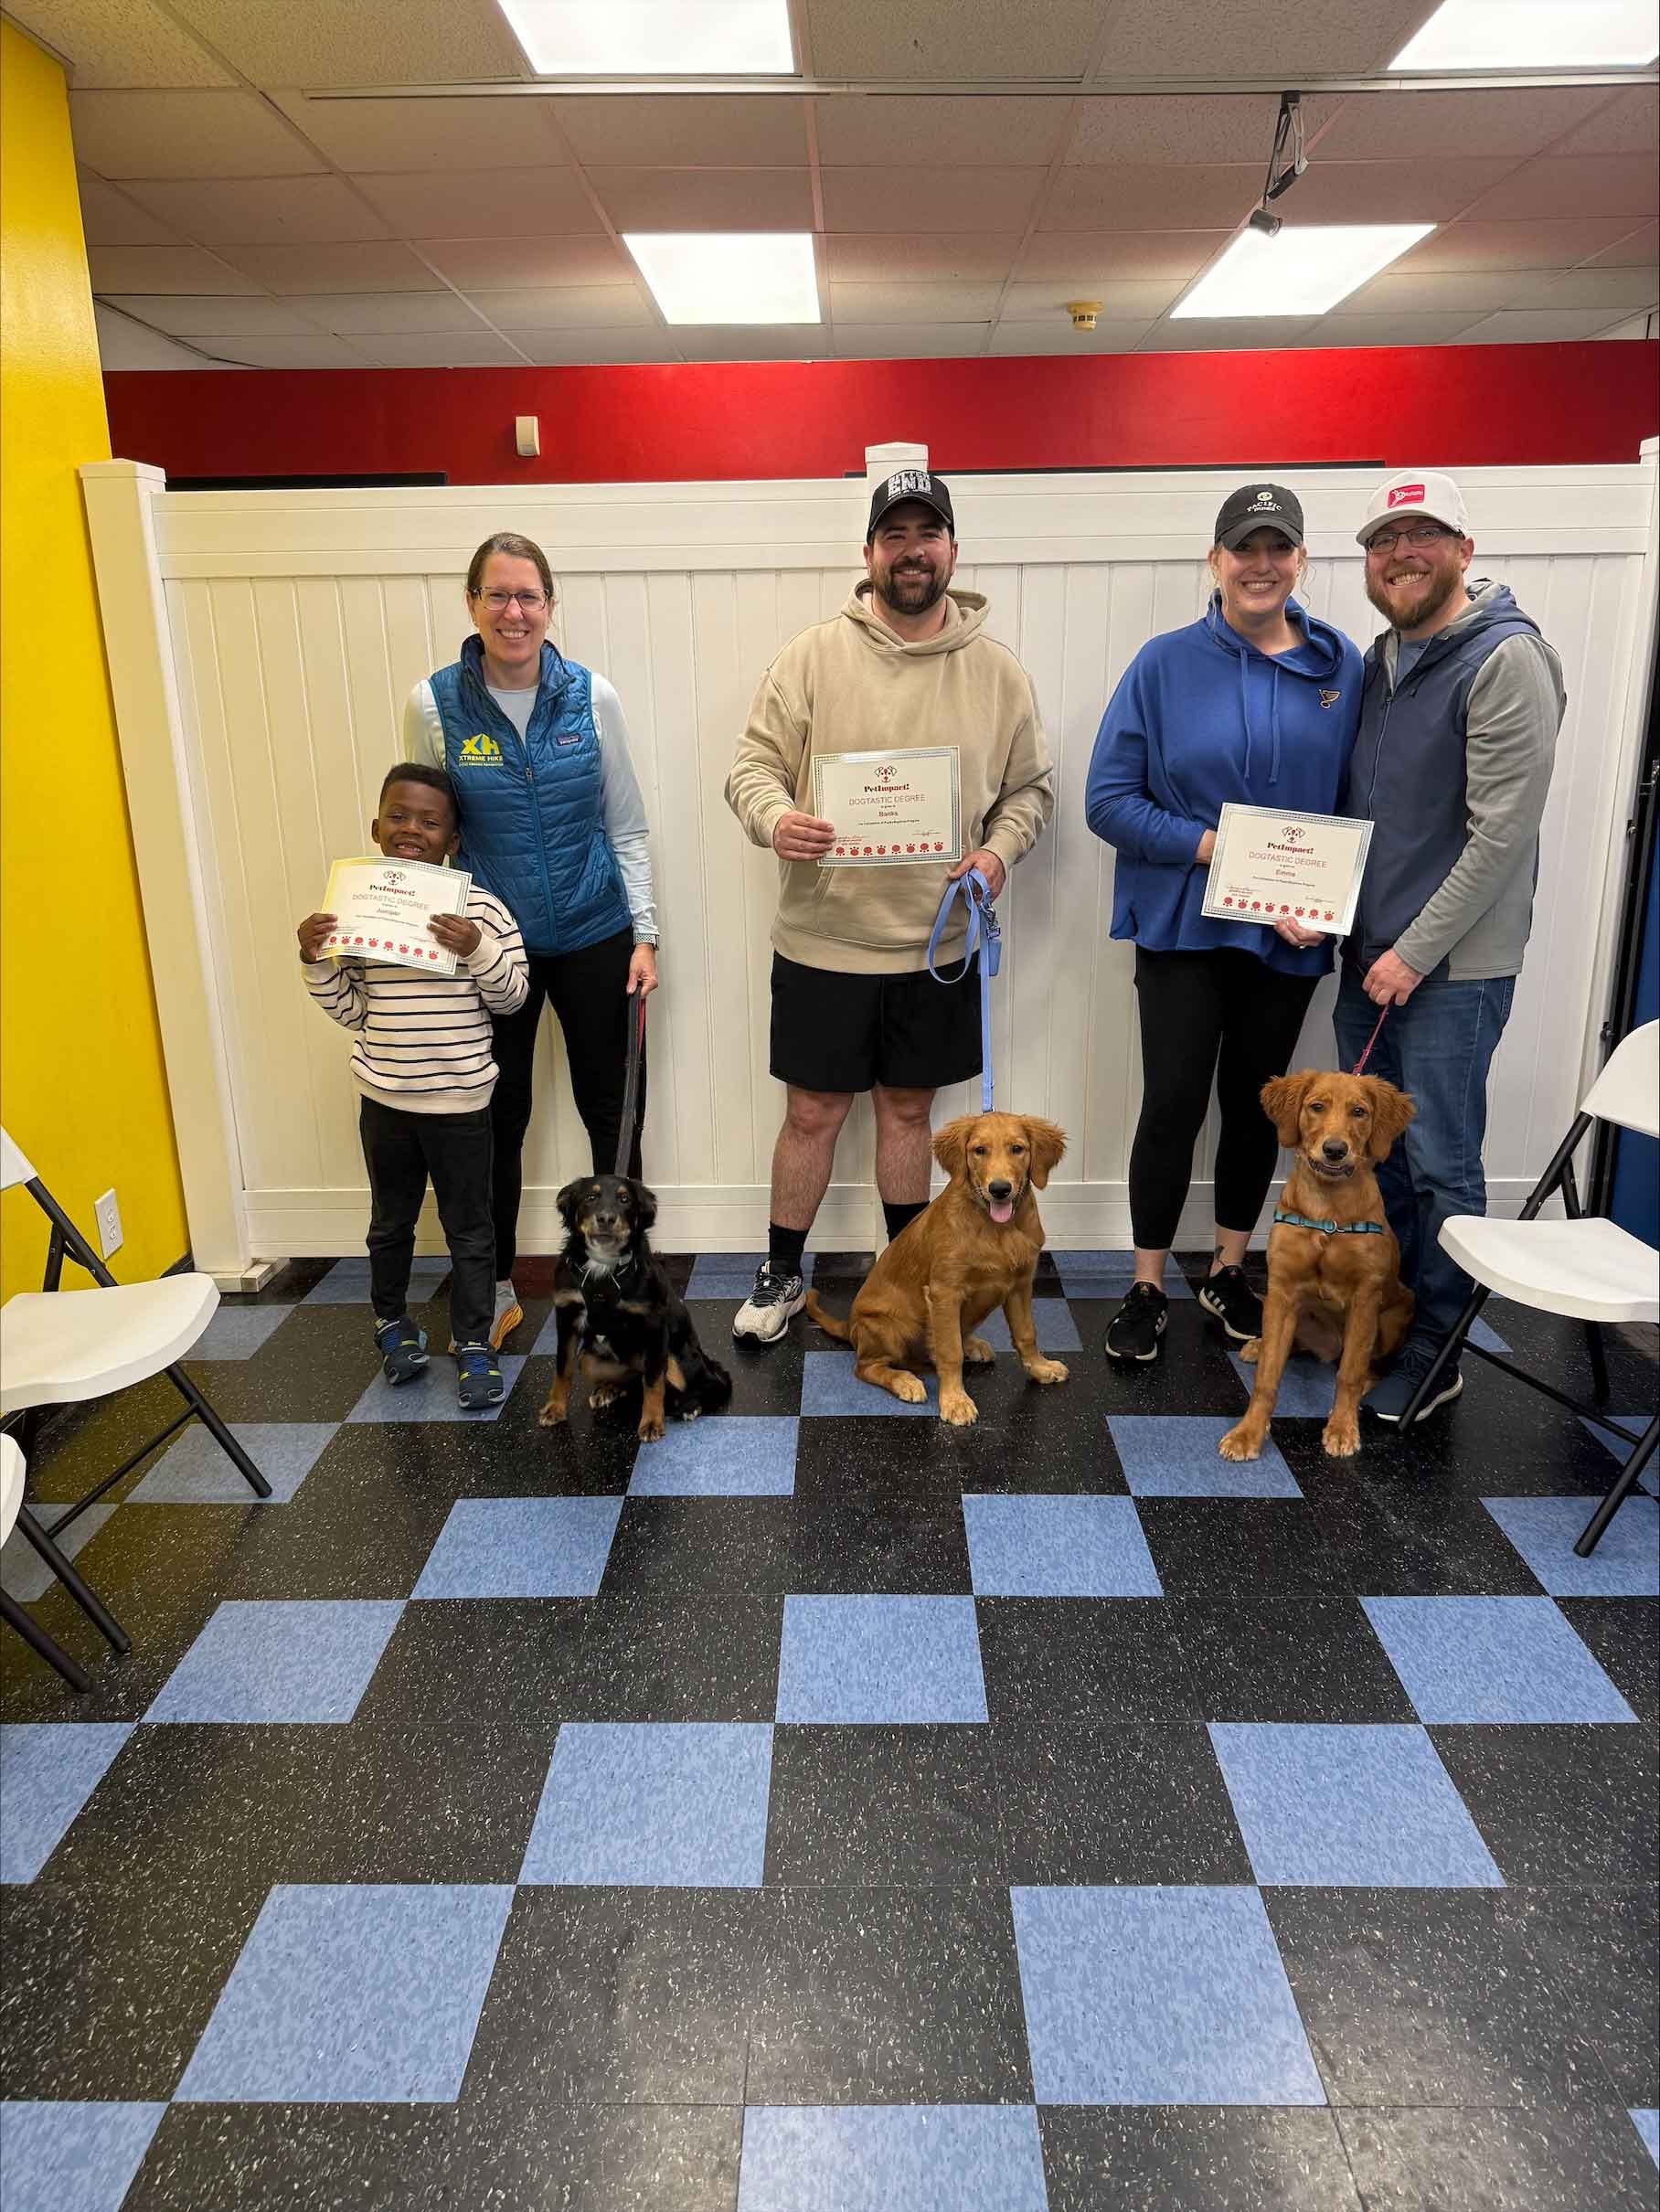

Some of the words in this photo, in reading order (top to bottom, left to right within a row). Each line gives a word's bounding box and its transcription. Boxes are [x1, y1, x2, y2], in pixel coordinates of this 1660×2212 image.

[1246, 501, 1282, 513] PACIFIC
[848, 796, 893, 805] DOGTASTIC
[894, 793, 926, 803] DEGREE
[1266, 842, 1314, 855] PetImpact!
[1249, 851, 1293, 864] DOGTASTIC
[1294, 856, 1328, 868] DEGREE
